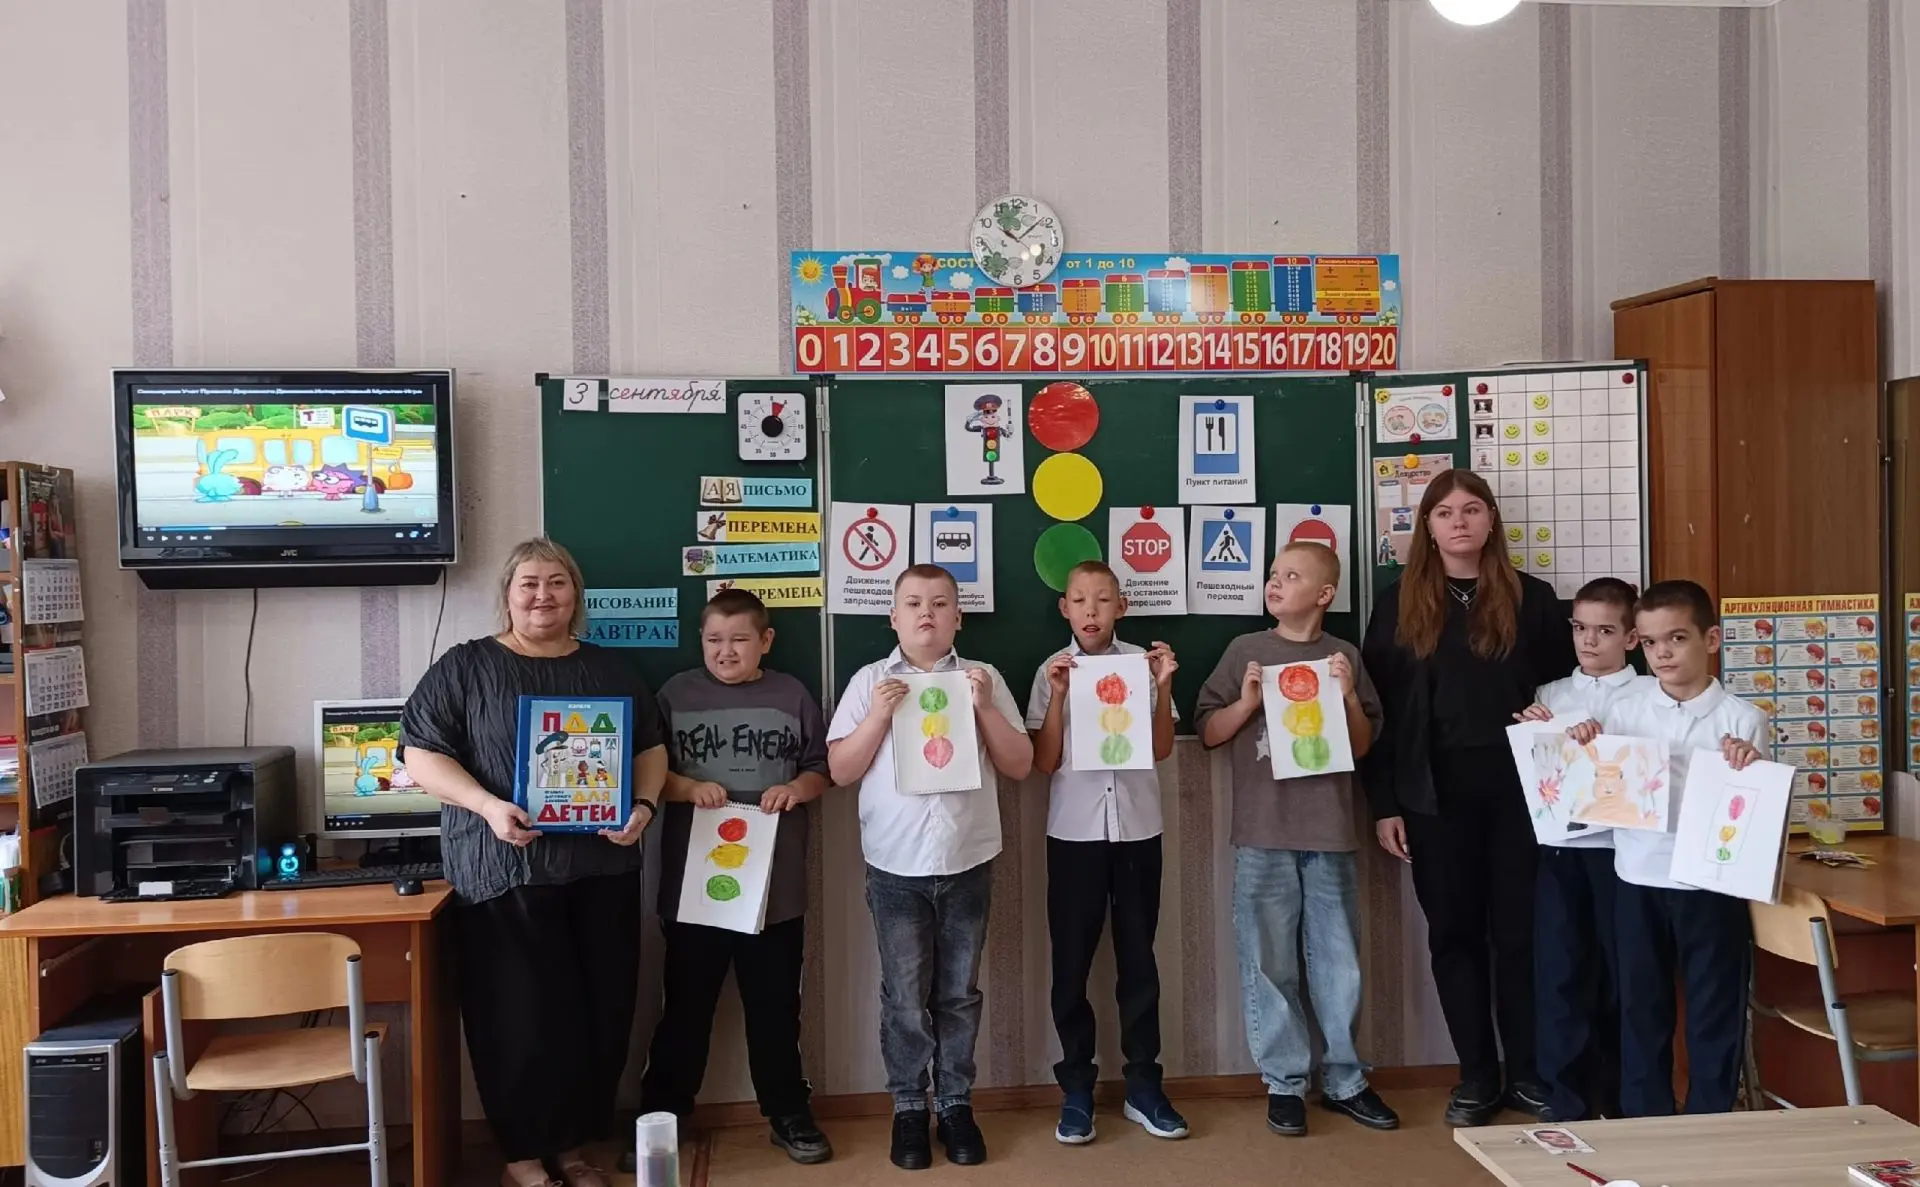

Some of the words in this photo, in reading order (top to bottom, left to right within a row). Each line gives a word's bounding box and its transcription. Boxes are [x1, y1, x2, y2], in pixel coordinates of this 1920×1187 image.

[1010, 198, 1022, 209] 12
[1033, 204, 1038, 214] 1
[979, 217, 992, 229] 10
[1045, 217, 1053, 228] 2
[938, 257, 976, 268] СОСТ
[1066, 260, 1081, 269] от
[1086, 258, 1092, 268] 1
[1097, 260, 1114, 270] до
[1119, 258, 1135, 268] 10
[1045, 255, 1054, 265] 4
[1287, 257, 1297, 265] 10
[1014, 274, 1022, 285] 6
[1033, 269, 1041, 280] 5
[799, 333, 824, 366] 0
[833, 333, 848, 366] 1
[858, 333, 882, 366] 2
[889, 333, 911, 366] 3
[917, 333, 941, 366] 4
[948, 333, 969, 366] 5
[975, 333, 999, 366] 6
[1005, 333, 1027, 366] 7
[1033, 333, 1056, 366] 8
[1062, 333, 1086, 366] 9
[1089, 333, 1117, 366] 10
[1119, 333, 1144, 366] 11
[1147, 333, 1175, 366] 12
[1176, 333, 1203, 366] 13
[1204, 333, 1231, 366] 14
[1233, 333, 1259, 366] 15
[1261, 333, 1287, 366] 16
[1289, 333, 1315, 366] 17
[1316, 333, 1341, 366] 18
[1344, 333, 1369, 366] 19
[1370, 333, 1396, 366] 20
[569, 382, 589, 405] 3
[1186, 478, 1210, 487] Пункт
[1213, 478, 1248, 486] питания
[707, 482, 720, 496] А
[726, 482, 736, 496] Я
[743, 485, 807, 496] ПИСЬМО
[728, 520, 818, 535] ПЕРЕМЕНА
[280, 549, 298, 557] JVC
[1124, 539, 1170, 556] STOP
[716, 549, 818, 565] МАТЕМАТИКА
[845, 575, 891, 585] Движение
[1126, 579, 1169, 587] Движение
[843, 586, 893, 596] пешеходов
[1197, 581, 1255, 591] Пешеходный
[748, 586, 823, 600] РЕМЕНА
[1207, 593, 1244, 601] переход
[584, 596, 676, 609] ИСОВАНИЕ
[843, 597, 892, 607] запрещено
[1128, 600, 1172, 608] апрещено
[1725, 600, 1813, 614] АРТИКУЛЯЦИОННАЯ
[1816, 598, 1875, 608] ГИМНАСТИКА
[543, 711, 617, 733] ПДД
[677, 723, 728, 763] REAL
[571, 790, 611, 803] ДЛЯ
[537, 803, 617, 822] ДЕТЕЙ
